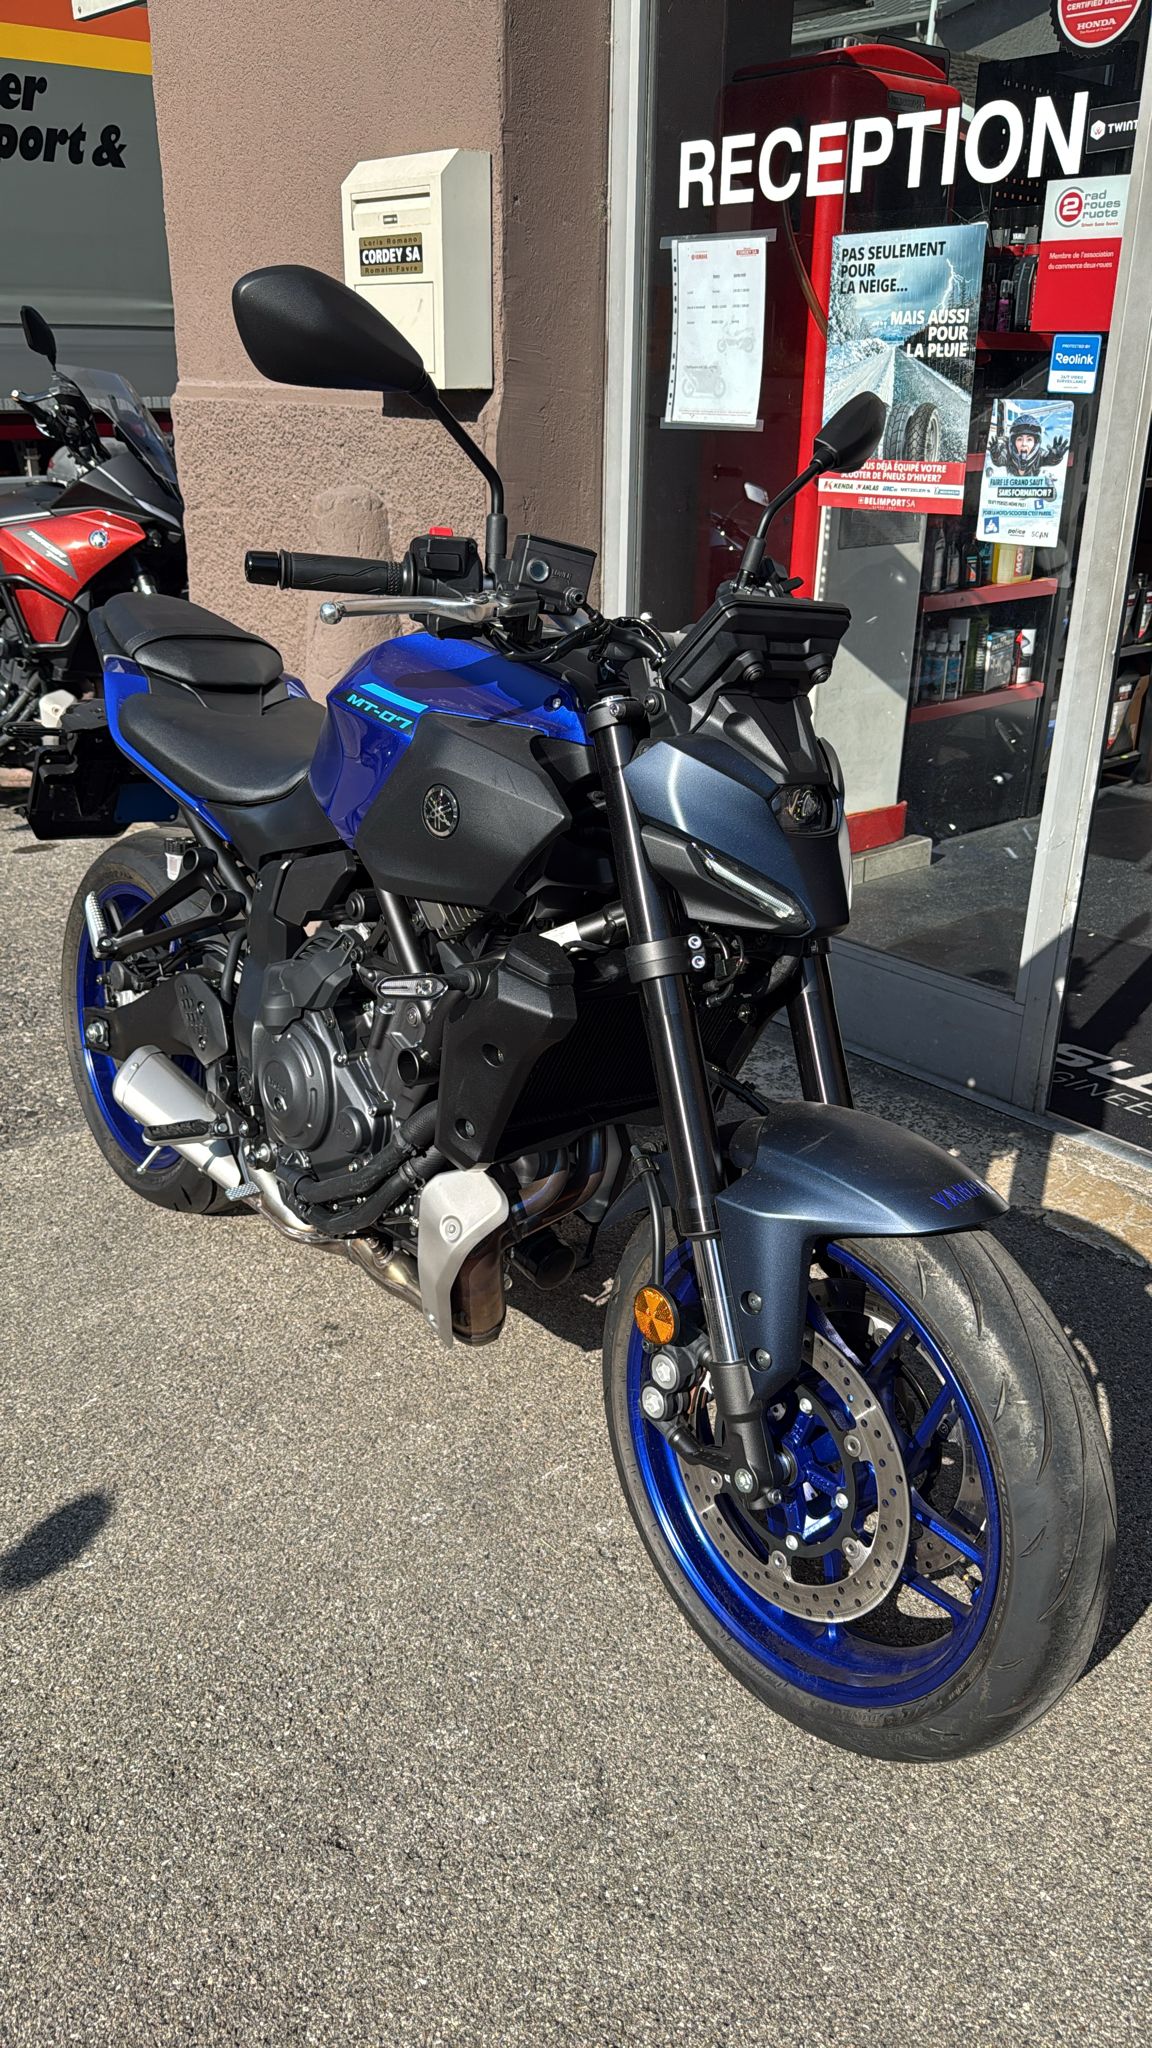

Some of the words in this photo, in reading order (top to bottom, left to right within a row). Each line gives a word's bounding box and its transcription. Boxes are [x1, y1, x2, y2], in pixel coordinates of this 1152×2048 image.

[1077, 18, 1117, 30] HONDA
[1108, 119, 1138, 134] TWINT
[92, 124, 127, 168] &
[679, 91, 1089, 209] RECEPTION
[1062, 197, 1080, 215] 2
[1084, 189, 1107, 201] rad
[1083, 200, 1121, 210] roues
[1082, 209, 1118, 219] ruote
[386, 236, 418, 245] Romano
[362, 247, 403, 265] CORDEY
[405, 246, 421, 262] SA
[842, 247, 865, 262] PAS
[868, 241, 947, 261] SEULEMENT
[1049, 252, 1072, 260] Membre
[1072, 251, 1080, 259] de
[364, 266, 393, 274] Romain
[396, 265, 418, 273] Favre
[841, 263, 876, 278] POUR
[1048, 262, 1055, 270] du
[840, 281, 856, 295] LA
[859, 278, 908, 294] NEIGE...
[890, 310, 925, 325] MAIS
[928, 308, 970, 324] AUSSI
[928, 326, 968, 341] POUR
[906, 344, 925, 358] LA
[927, 342, 967, 358] PLUIE
[1055, 352, 1094, 365] Reolink
[876, 460, 892, 472] DÉJÀ
[894, 461, 919, 473] ÉQUIPÉ
[920, 464, 947, 473] VOTRE
[872, 471, 881, 480] DE
[882, 472, 906, 481] PNEUS
[907, 473, 942, 482] D'HIVER?
[990, 478, 1003, 486] FAIRE
[1030, 478, 1044, 486] SAUT
[999, 488, 1011, 497] SANS
[1012, 488, 1047, 497] FORMATION
[1031, 531, 1049, 539] SCAN
[347, 693, 413, 729] MT-07
